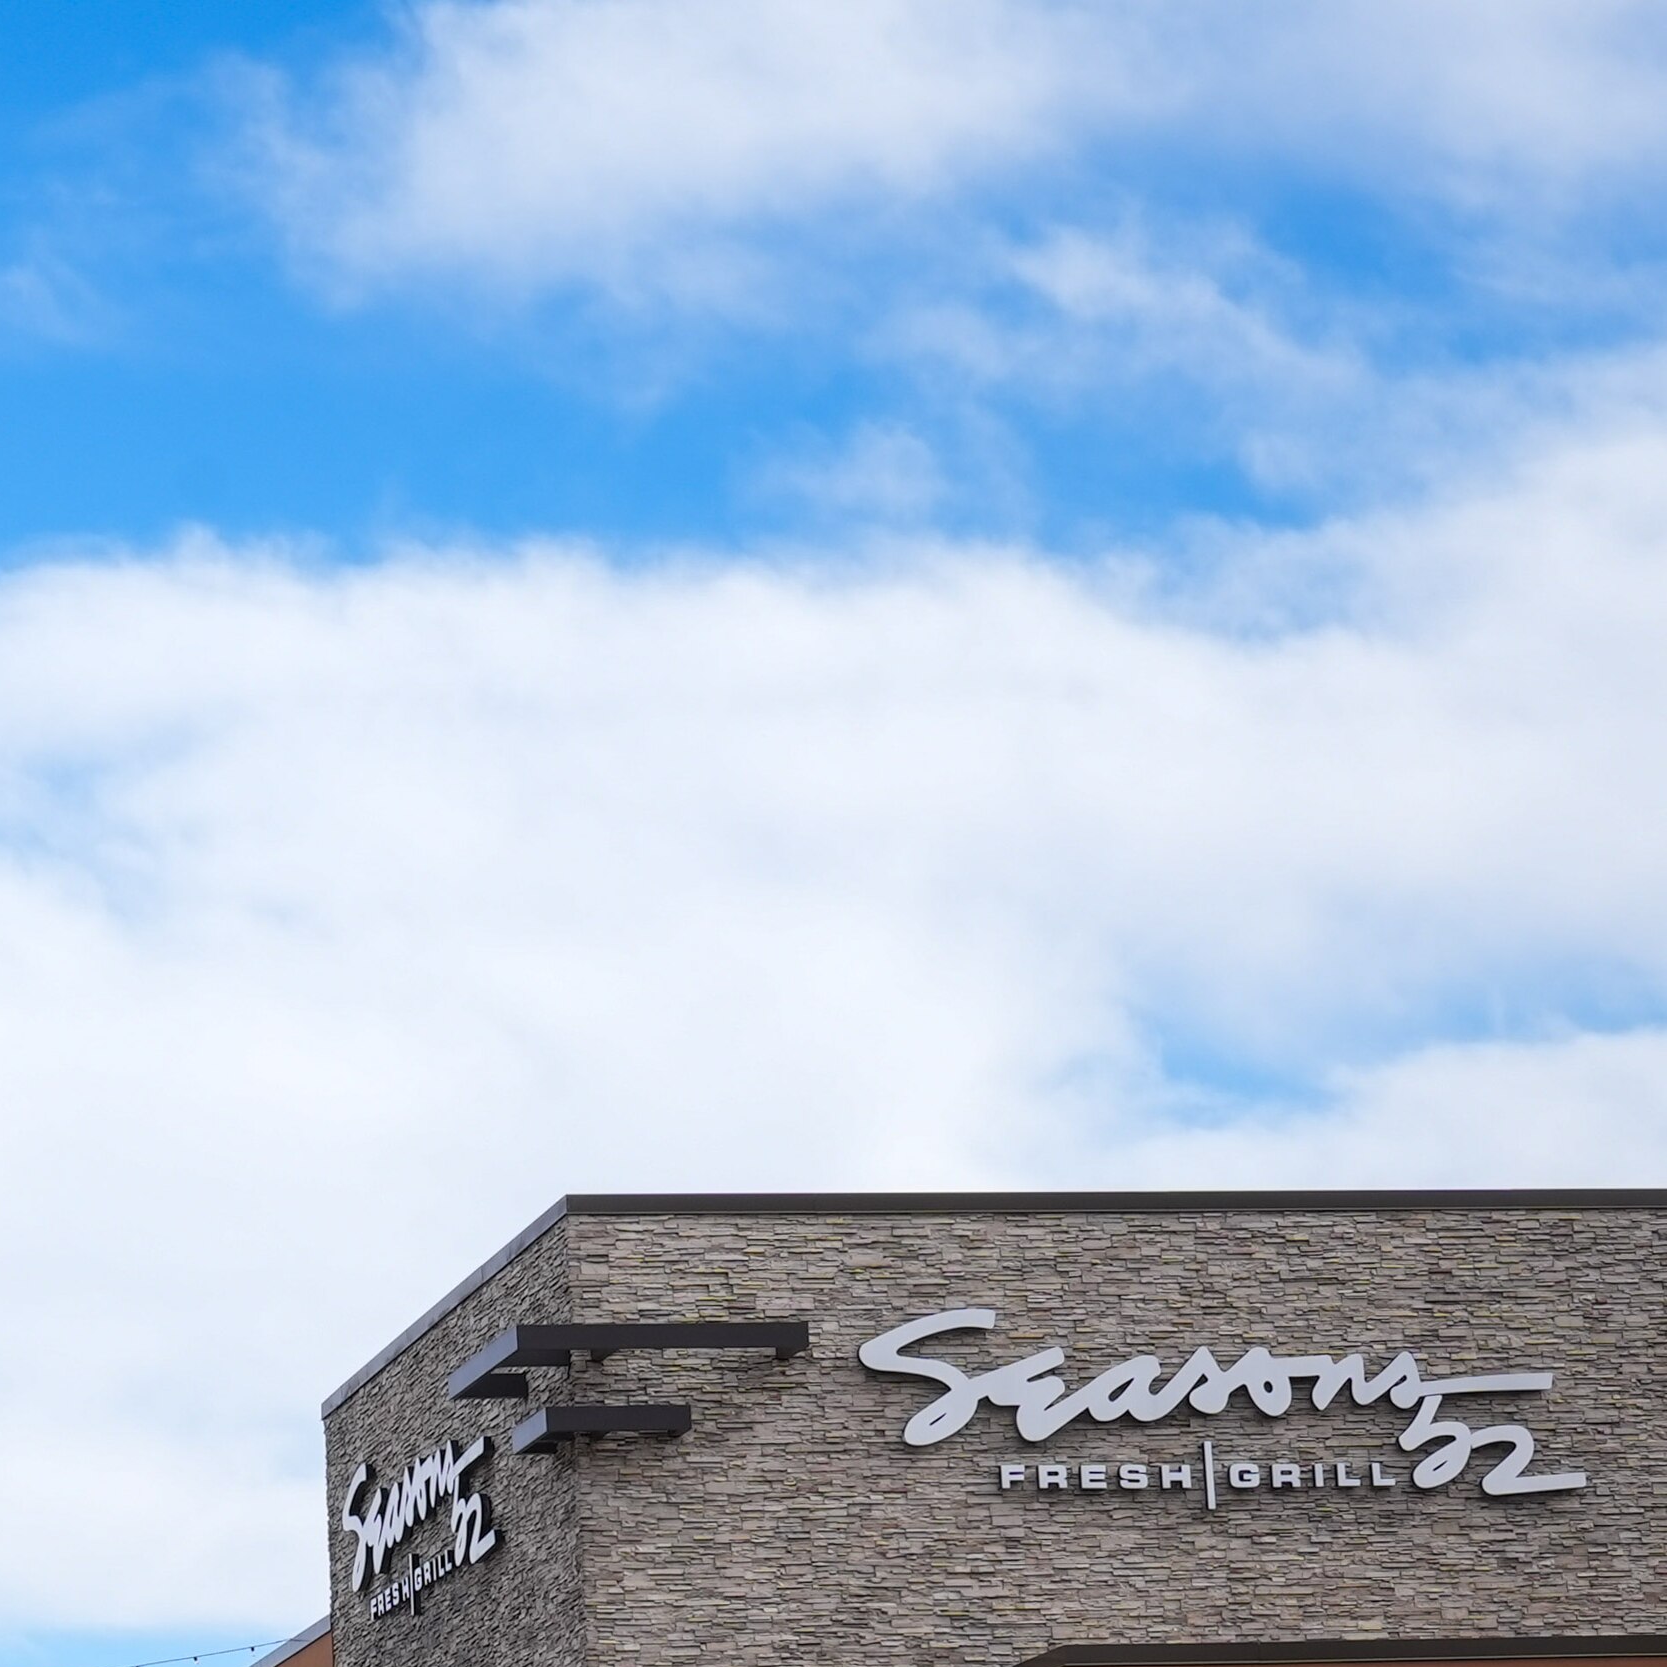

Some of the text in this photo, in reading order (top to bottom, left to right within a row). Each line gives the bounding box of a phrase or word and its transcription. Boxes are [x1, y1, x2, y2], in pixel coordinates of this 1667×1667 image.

[858, 1308, 1587, 1496] Seasons 52
[998, 1461, 1397, 1490] FRESH GRILL
[342, 1436, 497, 1593] Seasons 52
